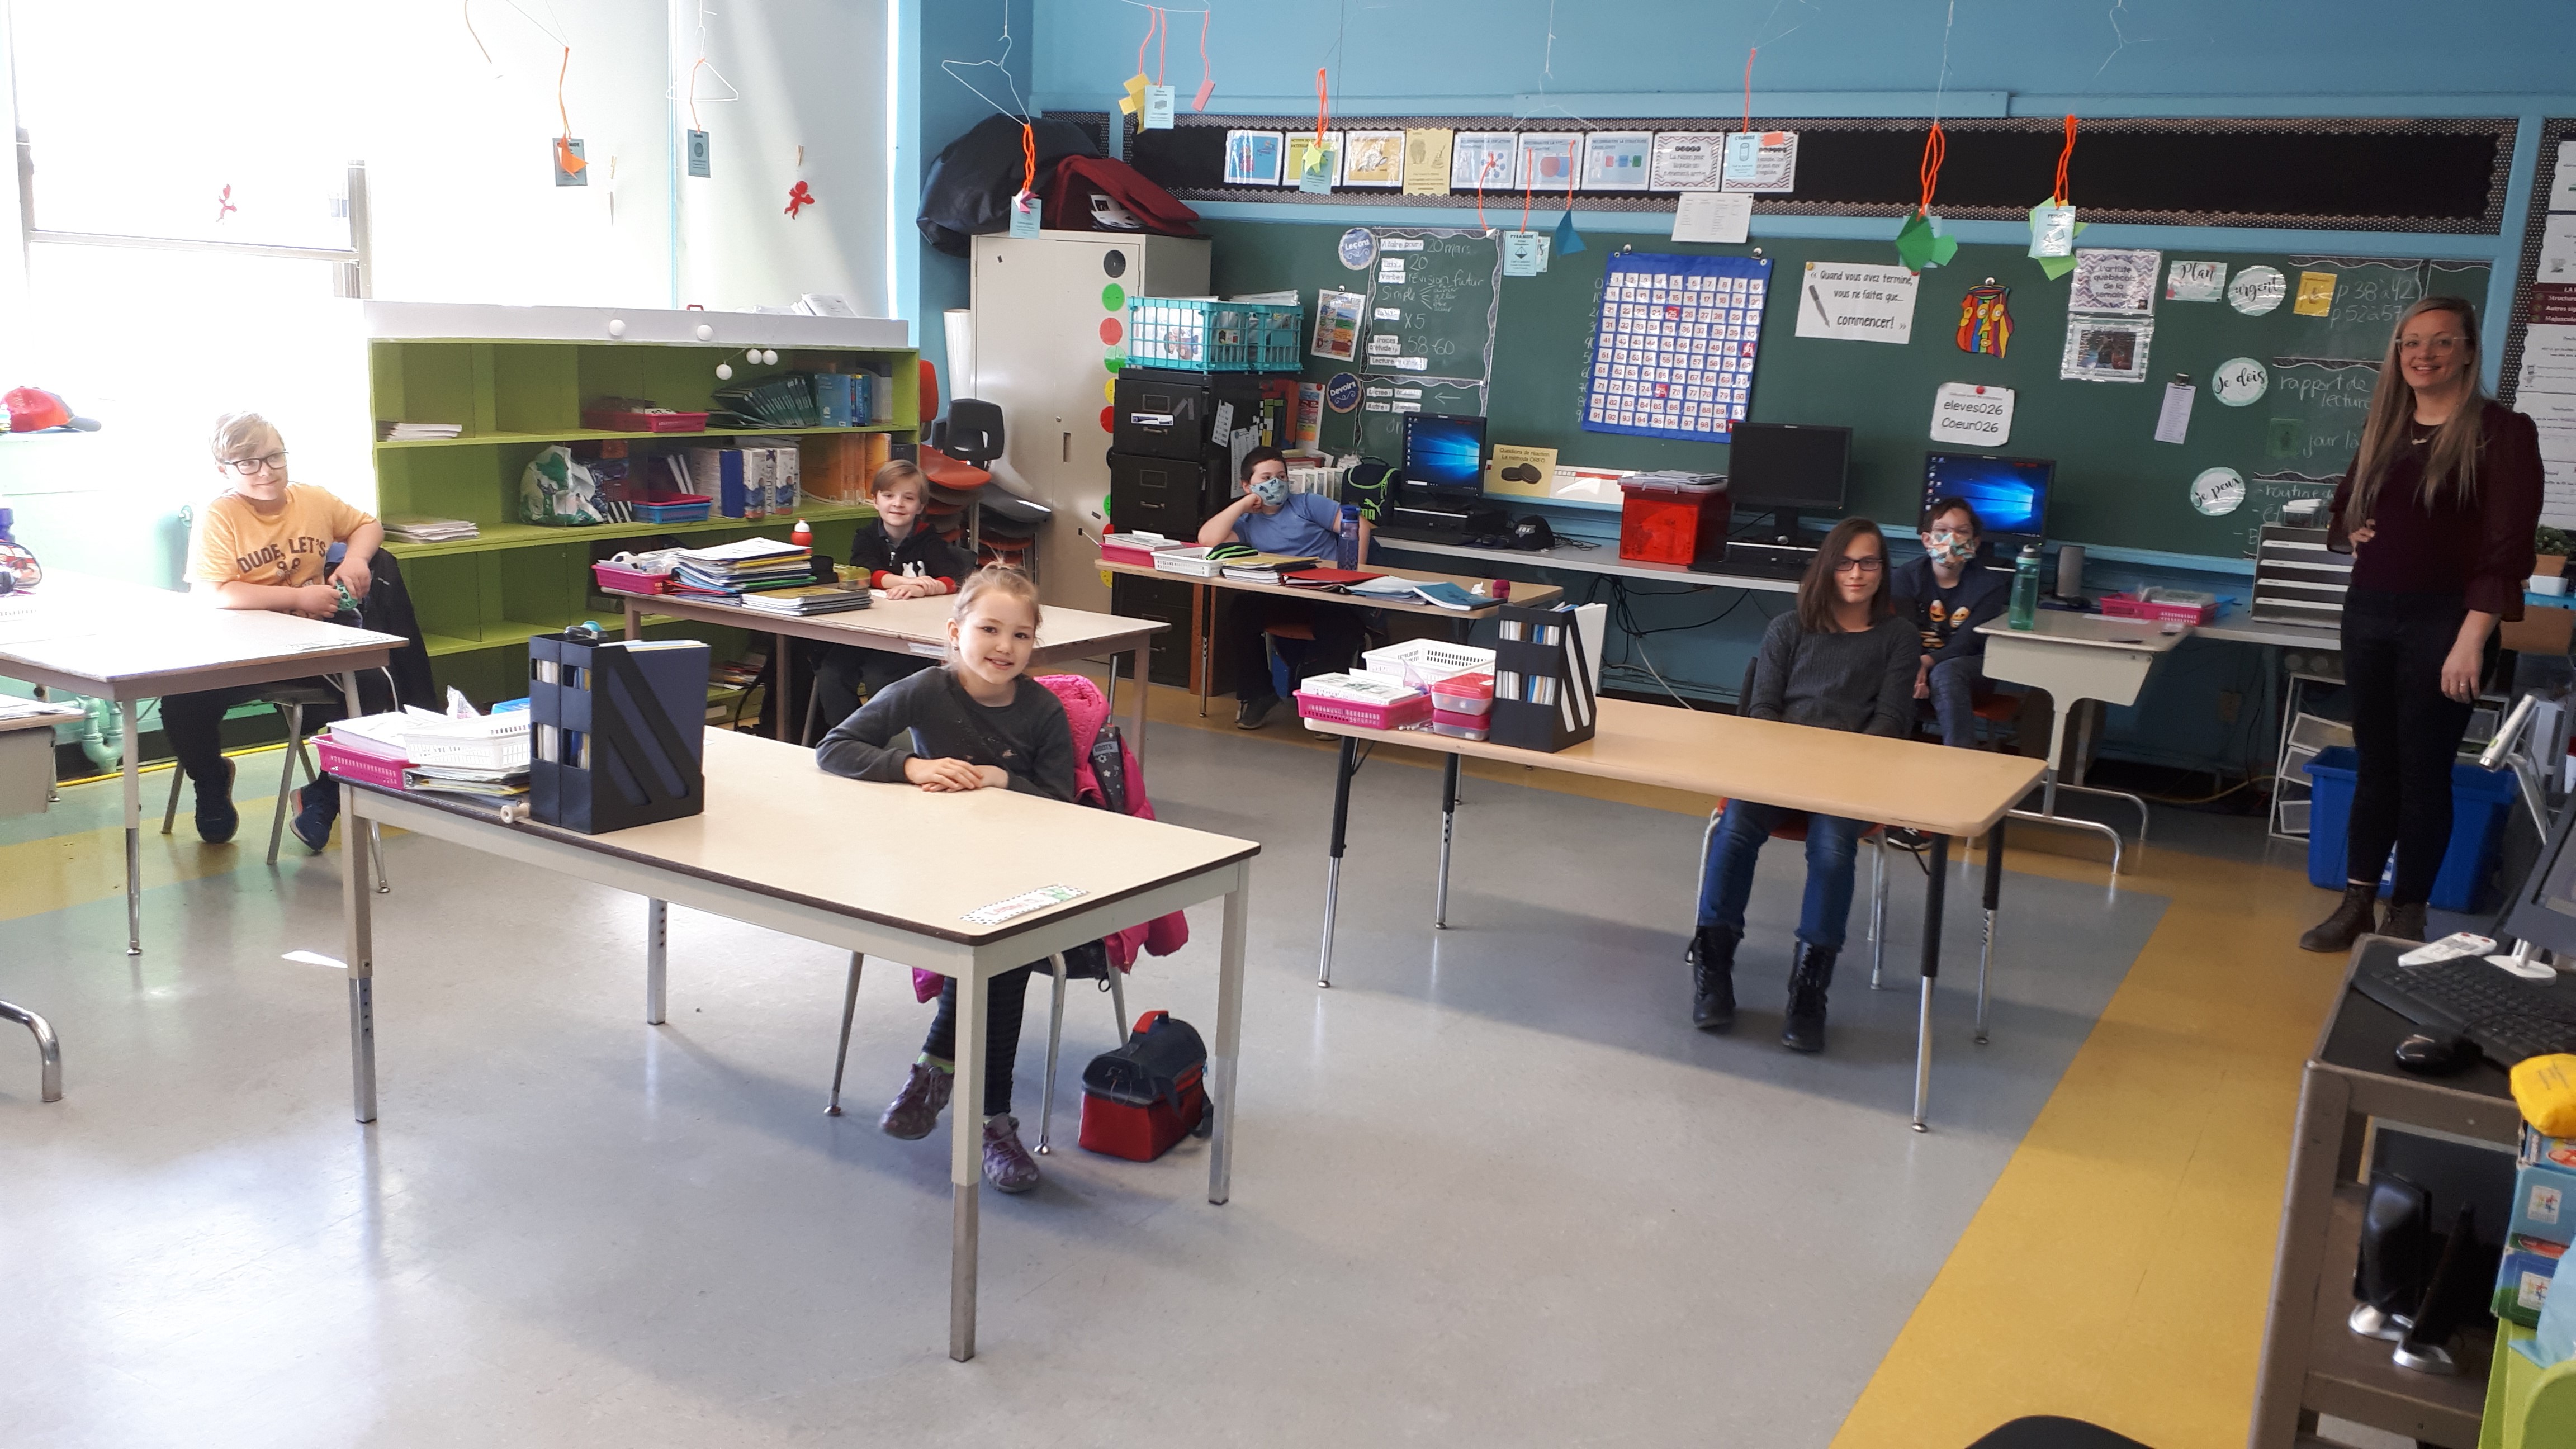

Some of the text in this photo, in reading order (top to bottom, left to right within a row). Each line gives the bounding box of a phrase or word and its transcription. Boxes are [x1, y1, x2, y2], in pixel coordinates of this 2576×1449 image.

[1345, 239, 1370, 251] Leçons
[1427, 238, 1444, 253] 20
[1409, 254, 1428, 271] 20
[2099, 265, 2132, 273] L'artiste
[1820, 270, 1843, 280] Quand
[1864, 274, 1879, 283] avez
[1883, 274, 1913, 286] terminé,
[2180, 262, 2214, 282] Plan
[1834, 290, 1850, 299] vous
[1862, 289, 1883, 300] faites
[2235, 277, 2279, 302] urgent
[2354, 281, 2378, 301] 38
[2392, 277, 2416, 301] 42
[1837, 315, 1895, 329] commencer!
[2346, 305, 2368, 323] 52
[1329, 381, 1356, 397] Devoirs
[2214, 367, 2265, 394] Je dois
[2280, 373, 2371, 401] rapport de
[1943, 400, 2004, 415] eleves026
[2321, 393, 2371, 410] lecture
[1942, 417, 1999, 433] Coeur026
[766, 465, 775, 514] LAROUSSE
[2193, 478, 2241, 508] je peux
[236, 536, 326, 574] DUDE, LET'S
